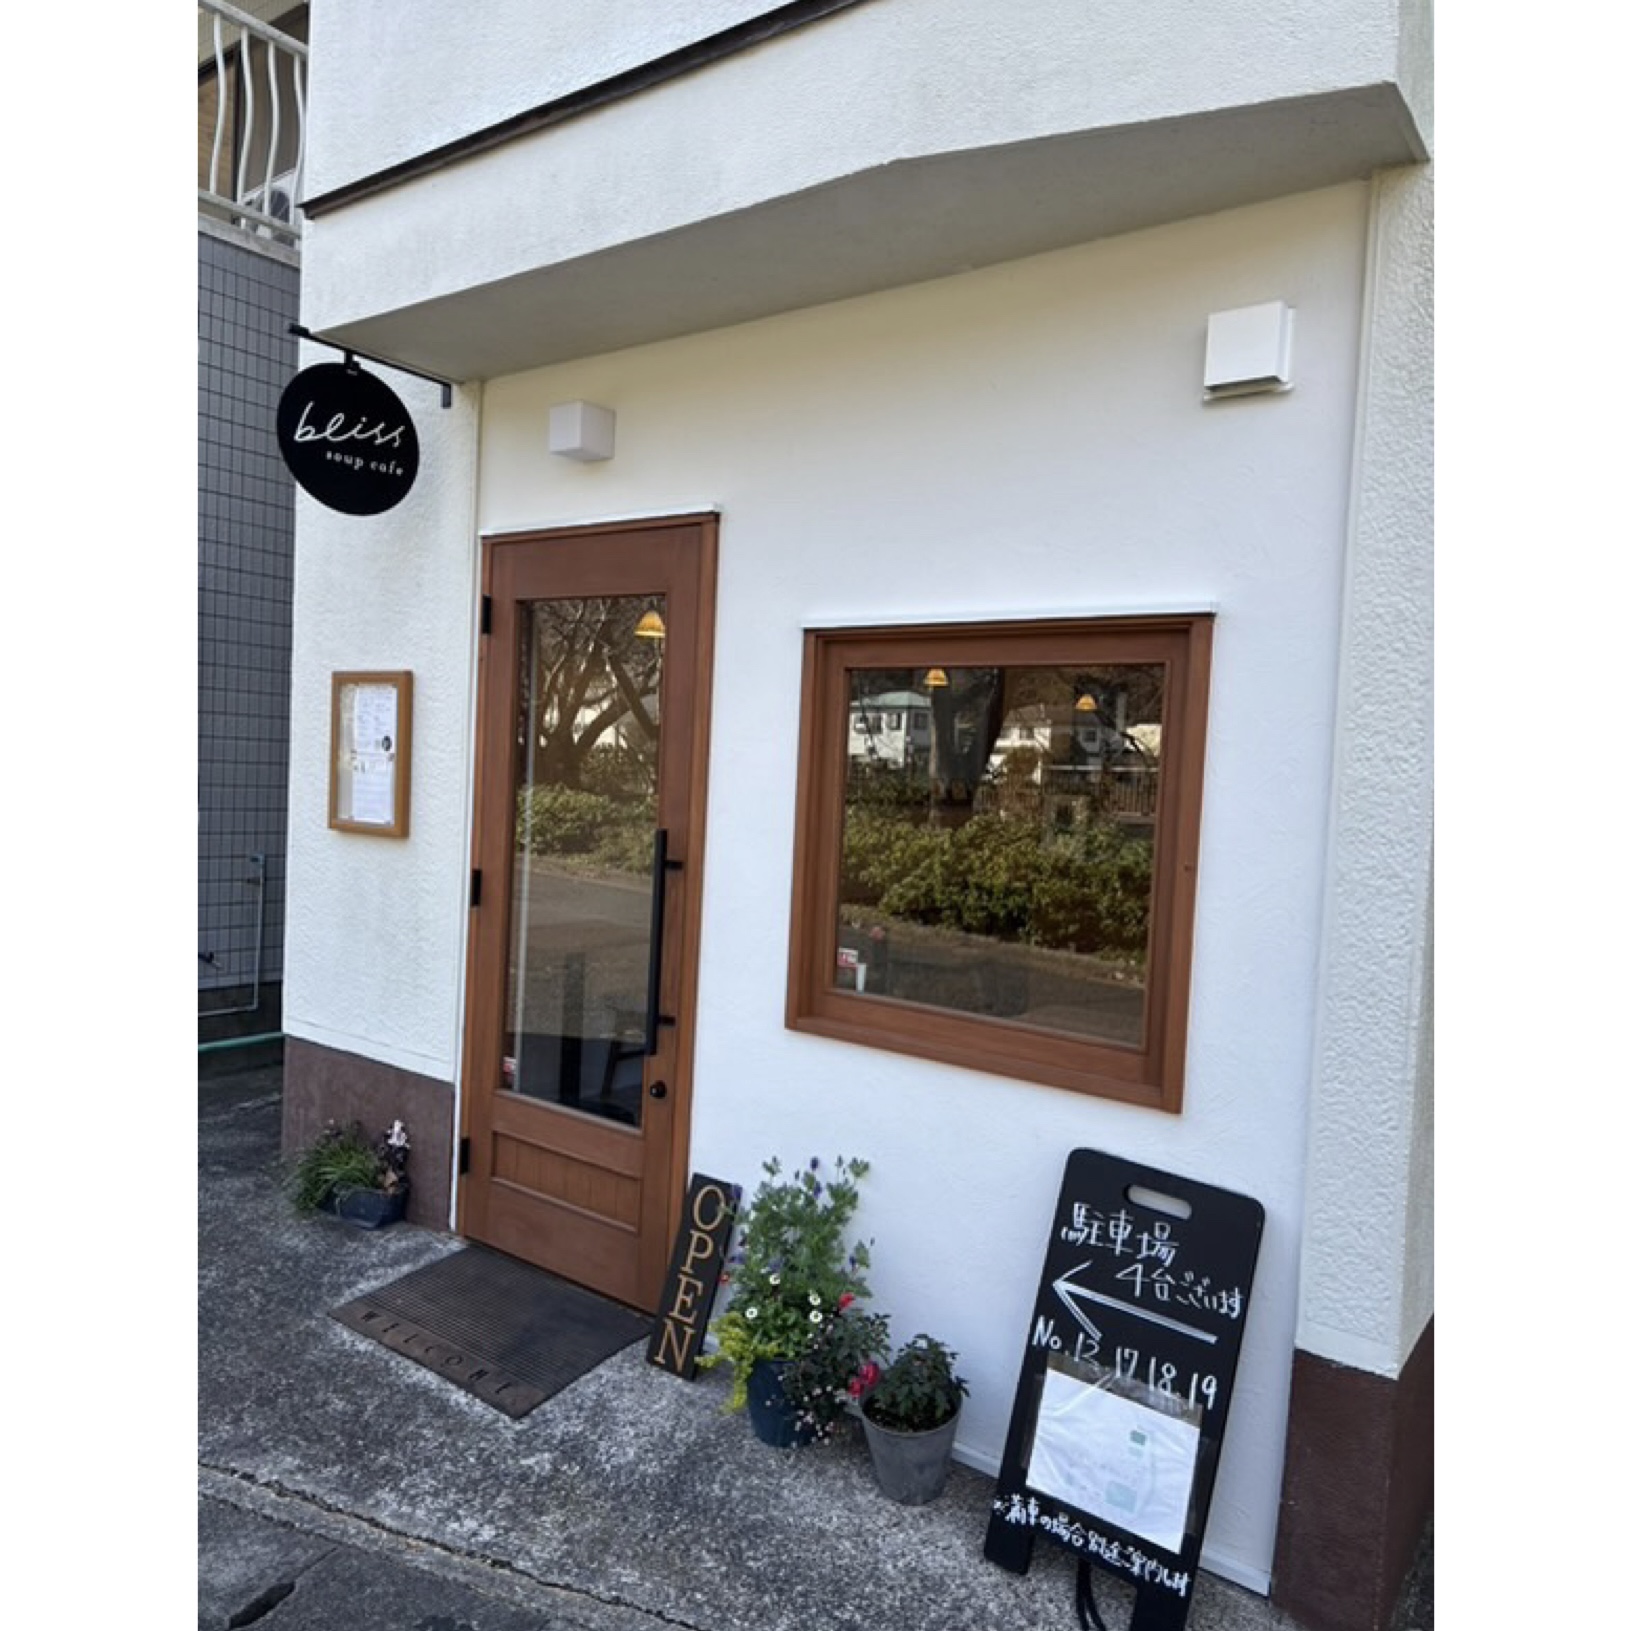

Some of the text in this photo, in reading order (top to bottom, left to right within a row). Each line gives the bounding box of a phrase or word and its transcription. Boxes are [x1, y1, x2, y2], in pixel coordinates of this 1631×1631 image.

[294, 401, 405, 447] bliss
[325, 450, 404, 475] soup cafe
[1060, 1201, 1179, 1267] 駐車場
[654, 1184, 726, 1372] OPEN
